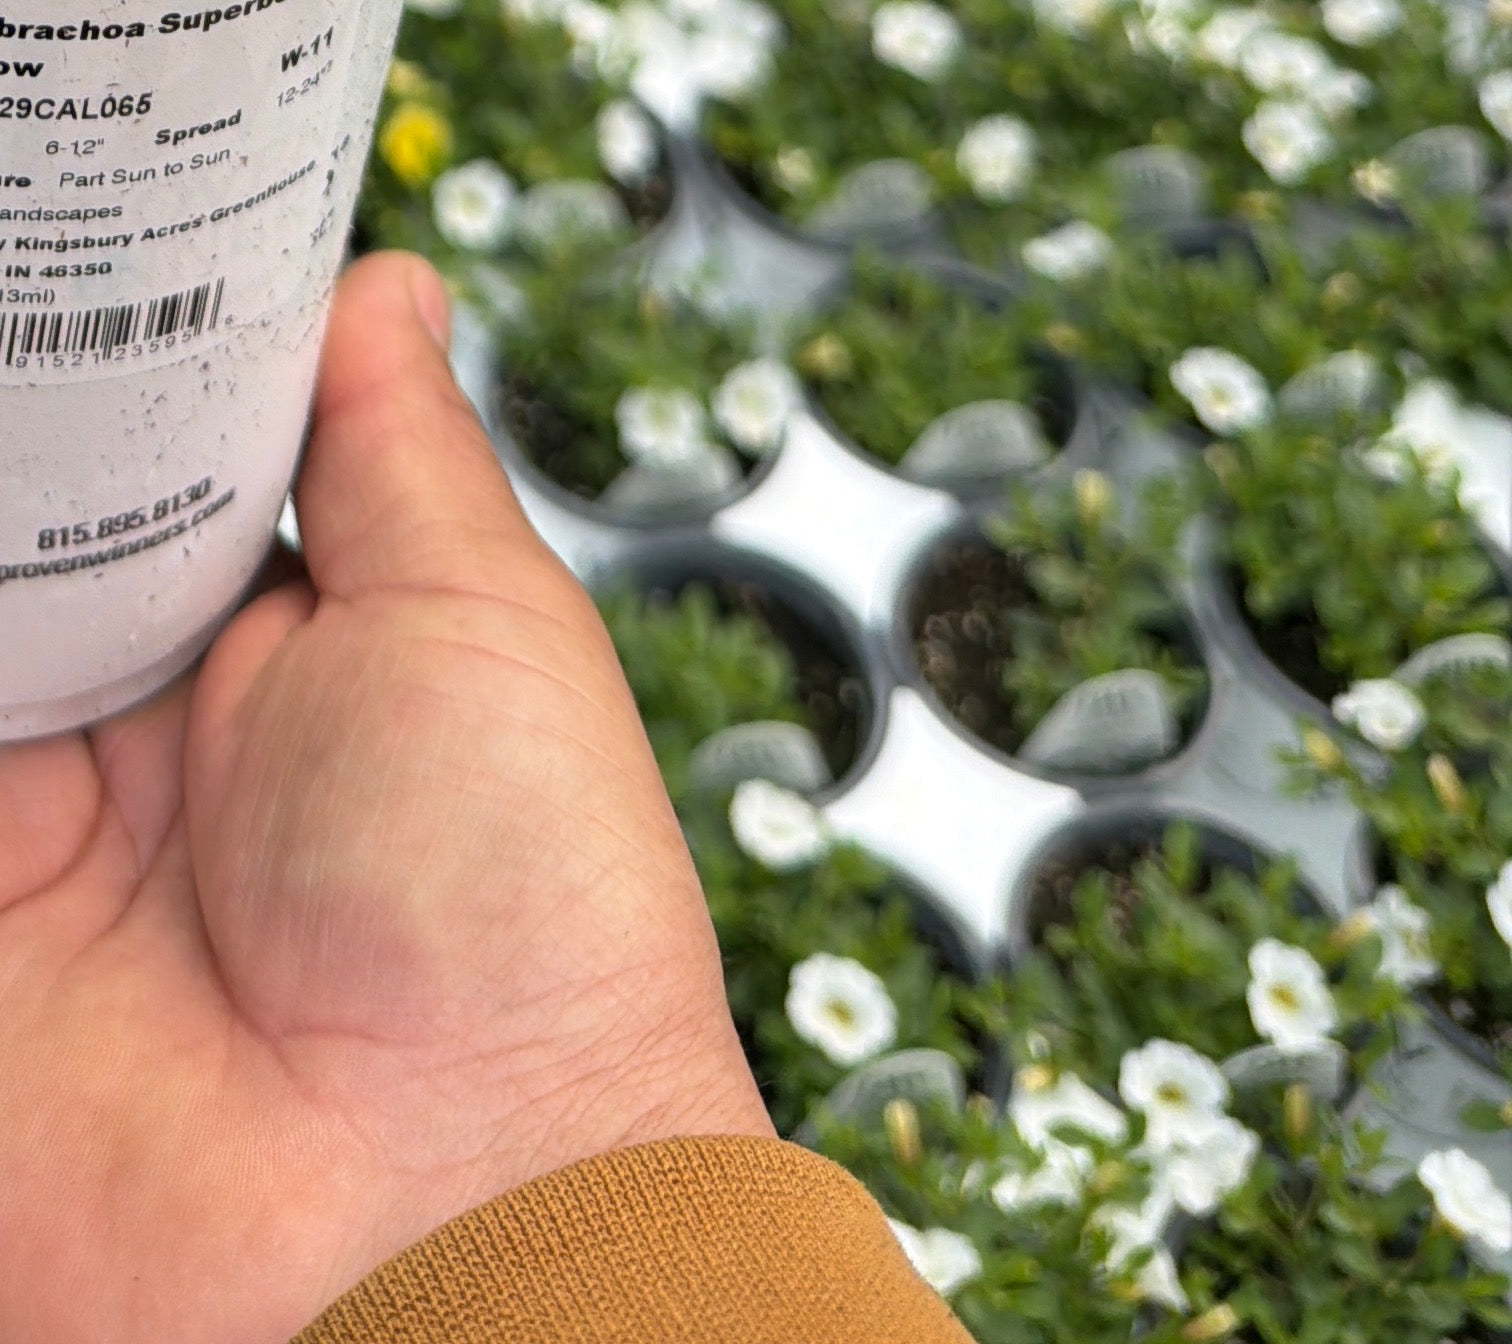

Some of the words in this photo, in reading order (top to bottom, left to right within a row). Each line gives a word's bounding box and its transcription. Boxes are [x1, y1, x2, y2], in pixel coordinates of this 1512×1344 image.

[281, 25, 334, 73] W-11
[45, 138, 105, 157] 6-12"
[155, 108, 242, 146] Spread
[59, 171, 106, 188] Part
[111, 167, 156, 185] Sun
[164, 161, 184, 177] to
[189, 148, 231, 171] Sun
[14, 231, 136, 254] Kingsbury
[140, 216, 204, 243] Acres
[4, 264, 31, 279] IN
[38, 261, 114, 279] 46350
[15, 352, 101, 369] 91521
[114, 330, 193, 362] 23595
[37, 475, 213, 551] 815.895.8130
